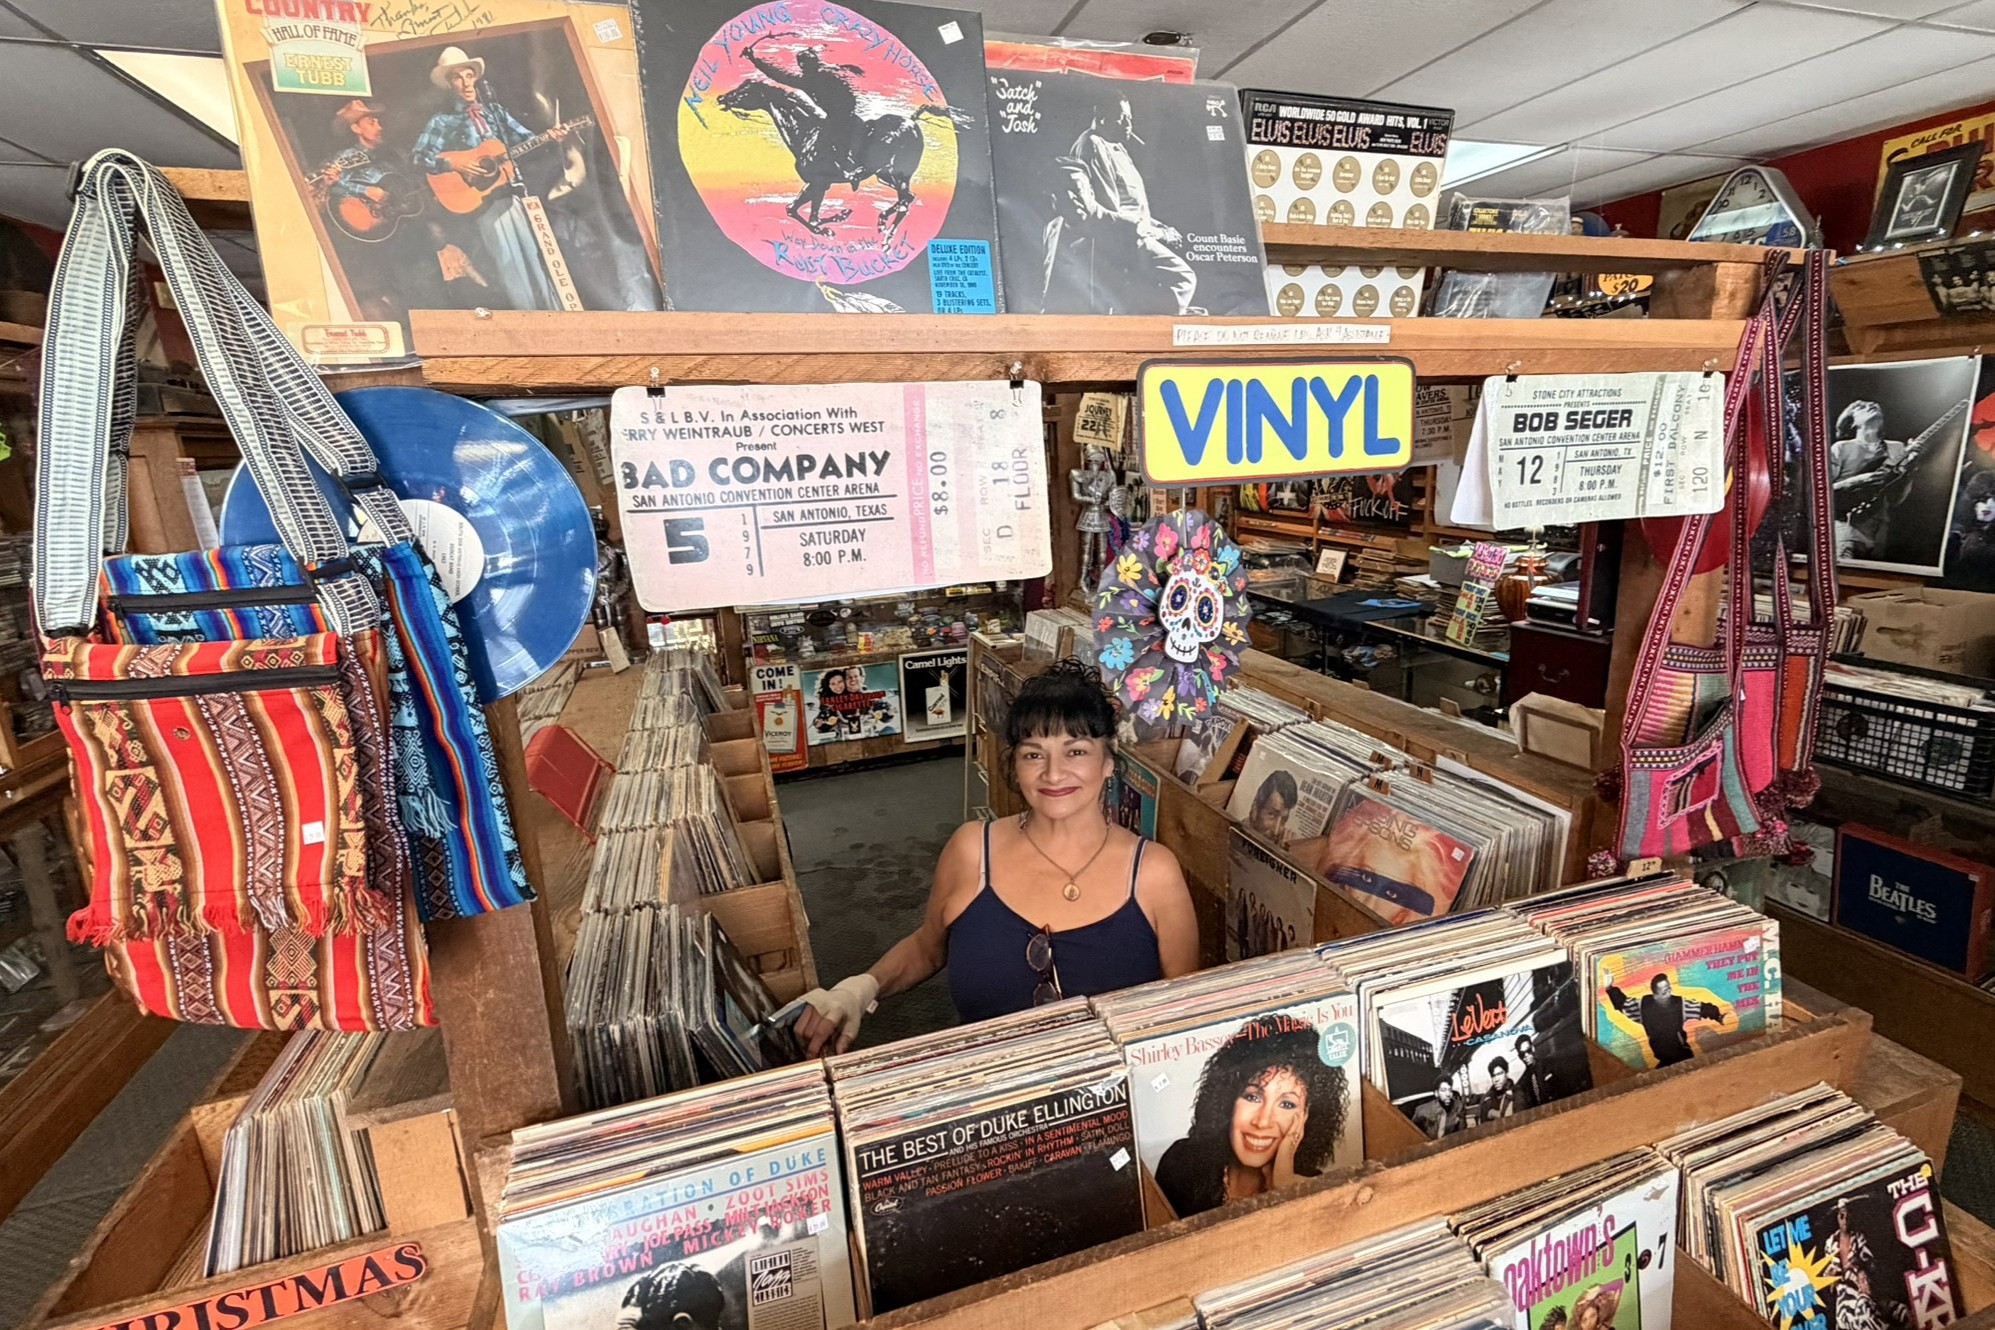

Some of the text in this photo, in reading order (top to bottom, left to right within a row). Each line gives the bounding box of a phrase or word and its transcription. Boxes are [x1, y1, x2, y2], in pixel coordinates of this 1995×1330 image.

[246, 0, 373, 23] COUNTRY
[272, 25, 358, 47] HALL OF FAME
[714, 3, 793, 64] YOUNG
[820, 7, 886, 51] CRAZY
[285, 53, 353, 71] ERNEST
[883, 43, 938, 102] HORSE
[296, 70, 345, 86] TUBB
[685, 59, 719, 129] NEIL
[1006, 100, 1034, 116] and
[1279, 106, 1385, 125] WORLDWIDE GOLD AWARD
[1251, 118, 1291, 143] ELVIS
[1292, 122, 1332, 146] ELVIS
[1332, 124, 1372, 149] ELVIS
[1410, 131, 1447, 155] ELVIS
[1911, 133, 1938, 148] CALL
[1939, 124, 1962, 139] FOR
[534, 214, 555, 255] GRAND
[1187, 232, 1246, 244] Count Basie
[828, 230, 916, 282] BUCKET
[931, 244, 986, 255] DELUXE EDITION
[1186, 252, 1258, 263] Oscar Peterson
[1193, 243, 1247, 253] encounters
[552, 260, 568, 287] OLE
[1611, 278, 1638, 294] $20
[1533, 388, 1622, 400] STONE CITY ATTRACTIONS
[685, 407, 857, 423] B.V. In Association With
[1081, 419, 1096, 431] 22
[1160, 374, 1400, 466] VINYL
[1513, 409, 1633, 433] BOB SEGER
[1668, 384, 1685, 449] BALCONY
[663, 421, 885, 440] WEINTRAUB CONCERTS WEST
[1499, 431, 1640, 447] SAN ANTONIO CONVENTION CENTER ARENA
[736, 442, 777, 451] Present
[1575, 450, 1588, 459] SAN
[1653, 423, 1667, 477] $12.00
[621, 450, 891, 489] BAD COMPANY
[1011, 448, 1032, 511] FLOOR
[1517, 455, 1544, 485] 12
[1580, 465, 1622, 477] THURSDAY
[1664, 460, 1675, 504] FIRST
[1692, 466, 1708, 492] 120
[633, 482, 880, 507] SAN ANTONIO CONVENTION CENTER ARENA
[930, 452, 948, 515] $8.00
[1579, 479, 1618, 491] 8:00 P.M.
[773, 504, 887, 523] SAN ANTONIO, TEXAS
[1351, 497, 1383, 518] FUCK
[663, 517, 709, 565] 5
[800, 528, 866, 546] SATURDAY
[803, 548, 867, 567] 8:00 P.M.
[756, 666, 794, 679] COME
[905, 655, 967, 670] Camel Lights
[1869, 874, 1937, 918] BEATLES
[1706, 951, 1758, 969] THEY PUT
[1728, 970, 1744, 980] ME
[1737, 981, 1759, 992] THE
[1451, 993, 1509, 1041] LeVert
[1131, 1044, 1183, 1066] Shirley
[1317, 1008, 1329, 1024] Is
[1331, 1004, 1353, 1020] You
[1466, 1025, 1533, 1046] CASANOVA
[859, 1145, 898, 1170] THE
[902, 1131, 947, 1159] BEST
[953, 1123, 976, 1145] OF
[980, 1109, 1028, 1138] DUKE
[1034, 1083, 1127, 1123] ELLINGTON
[863, 1110, 1129, 1190] WARM VALLEY PRELUDE KISS SENTIMENTAL MOOD
[949, 1123, 1048, 1156] AND FAMOUS ORCHESTRA
[729, 1148, 826, 1187] OF DUKE
[864, 1121, 1129, 1202] BLACK AND TAN FANTASY RHYTHM SATIN DOLL
[925, 1132, 1131, 1196] PASSION FLOWER BAKIFF CARAVAN FLAMINGO
[726, 1169, 829, 1210] ZOOT SIMS
[1887, 1174, 1929, 1199] THE
[574, 1252, 653, 1287] BROWN
[683, 1219, 760, 1255] MICKEY
[770, 1199, 832, 1230] ROKER
[643, 1231, 670, 1252] JOE
[674, 1219, 712, 1246] PASS
[1763, 1215, 1813, 1255] LET ME
[1777, 1284, 1817, 1320] YOUR
